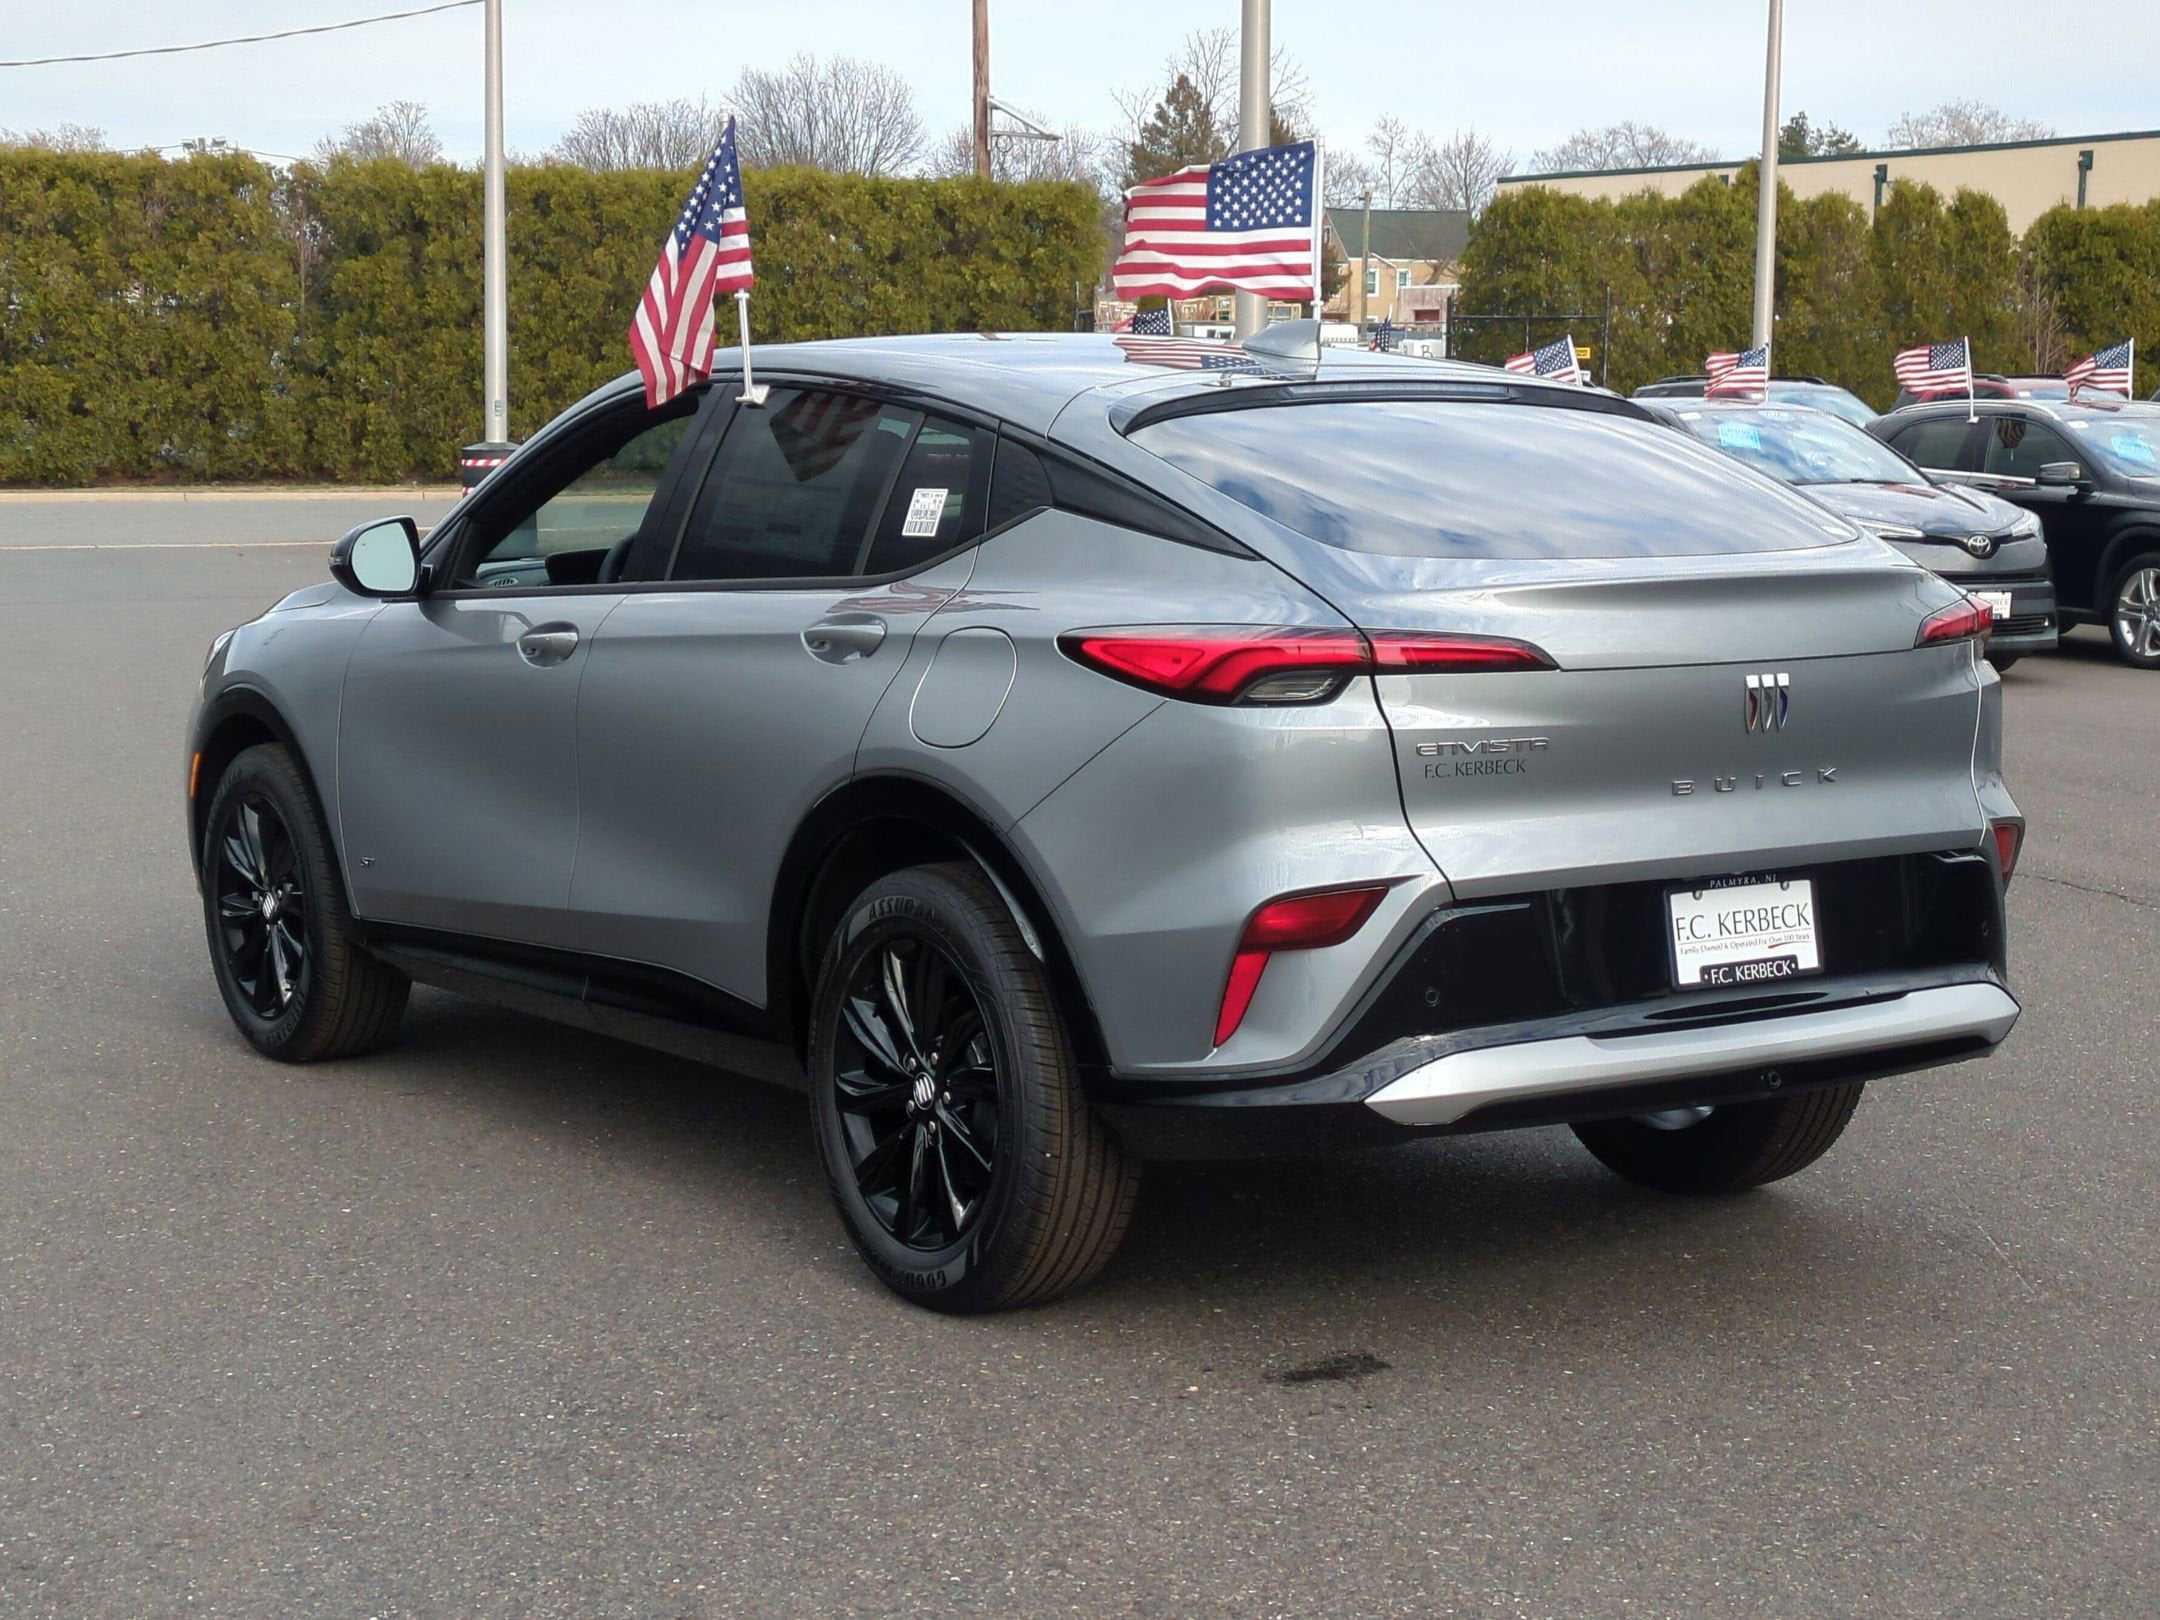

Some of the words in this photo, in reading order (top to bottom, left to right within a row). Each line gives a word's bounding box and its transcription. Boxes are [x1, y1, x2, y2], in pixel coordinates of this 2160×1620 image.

[1416, 737, 1550, 757] ENVISTA
[1424, 763, 1450, 779] F.C.
[1455, 758, 1527, 777] KERBECK
[1672, 767, 1838, 796] BUICK
[1765, 873, 1777, 883] NJ
[1675, 914, 1711, 941] F.C.
[1718, 902, 1811, 936] KERBECK
[1711, 968, 1733, 985] F.C.
[1736, 960, 1793, 981] KERBECK
